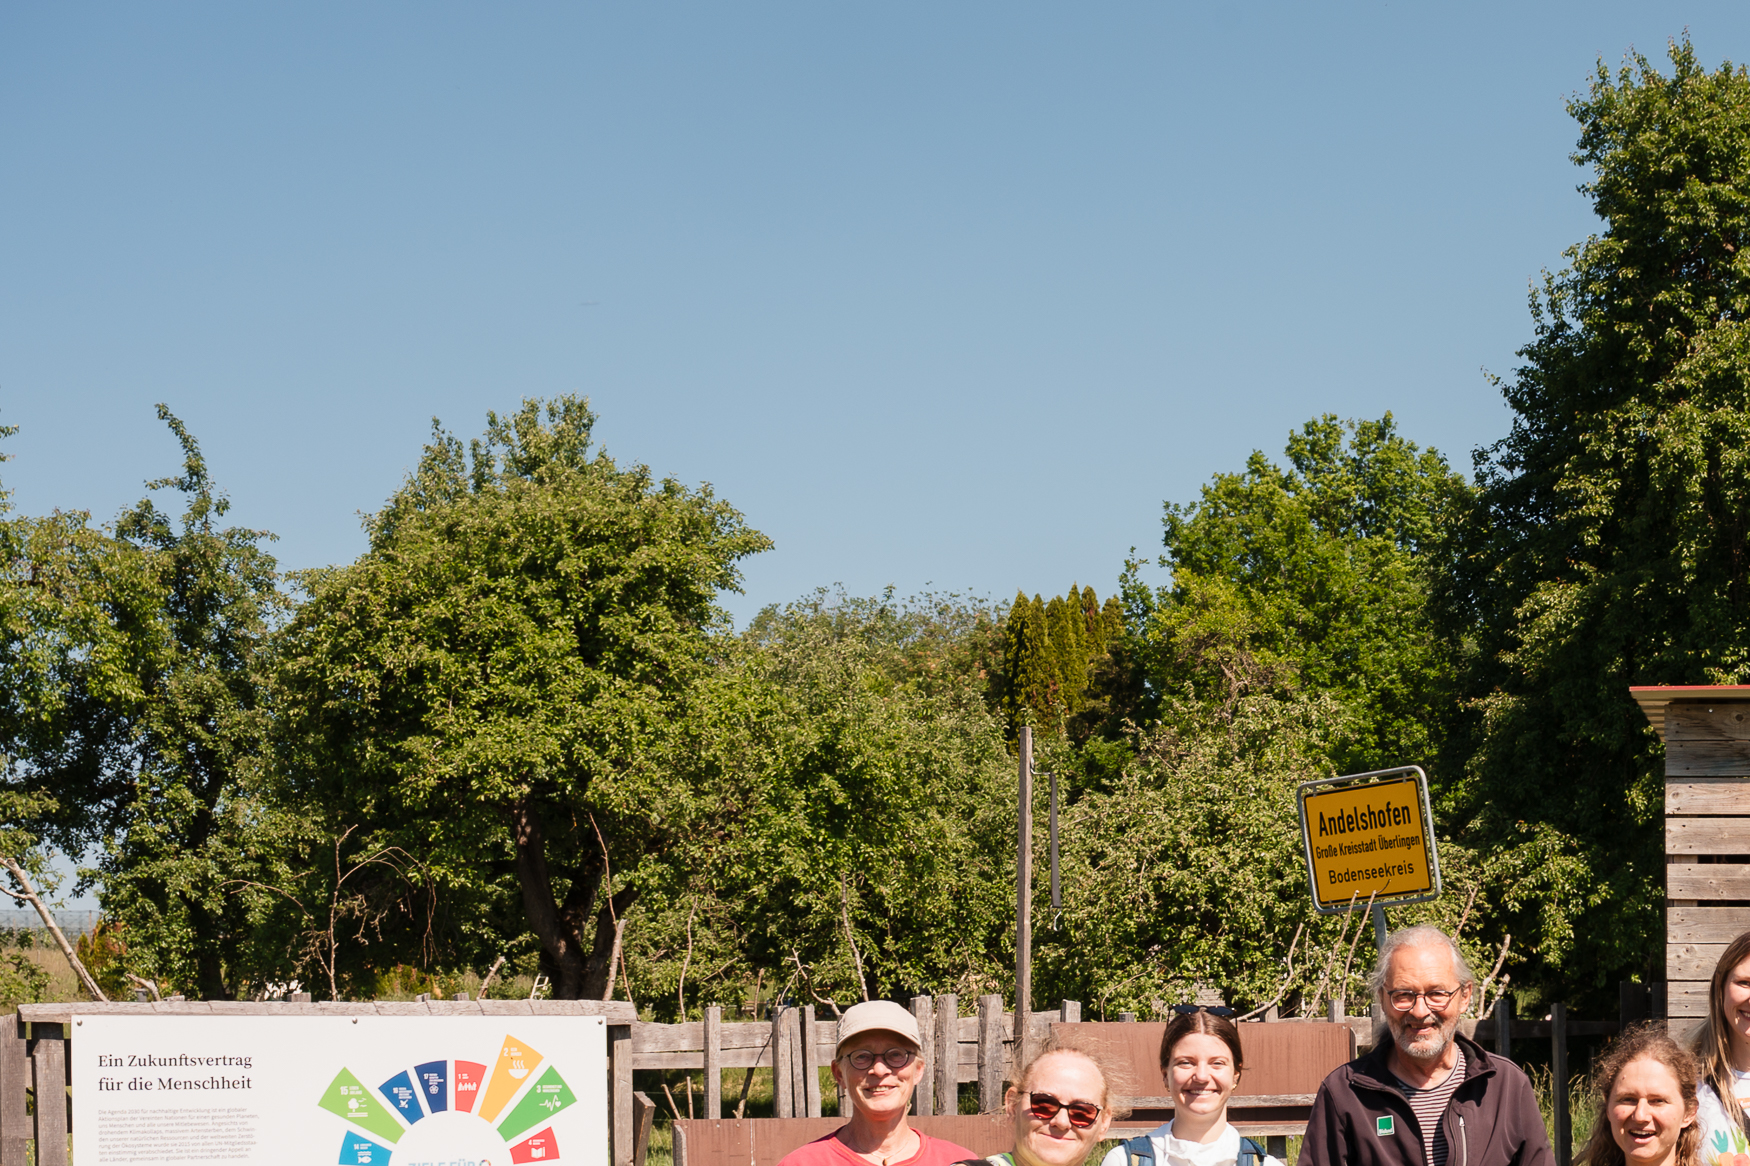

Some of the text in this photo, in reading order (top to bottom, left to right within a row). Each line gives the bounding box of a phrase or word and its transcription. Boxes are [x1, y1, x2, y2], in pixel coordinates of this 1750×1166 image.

[1319, 801, 1411, 837] Andelshofen
[1316, 834, 1420, 859] Große Kreisstadt Überlingen
[1329, 860, 1414, 884] Bodenseekreis
[504, 1048, 508, 1057] 2
[98, 1054, 252, 1069] Ein Zukunftsvertrag
[99, 1076, 252, 1091] für die Menschheit
[340, 1086, 348, 1095] 15
[536, 1085, 541, 1093] 3
